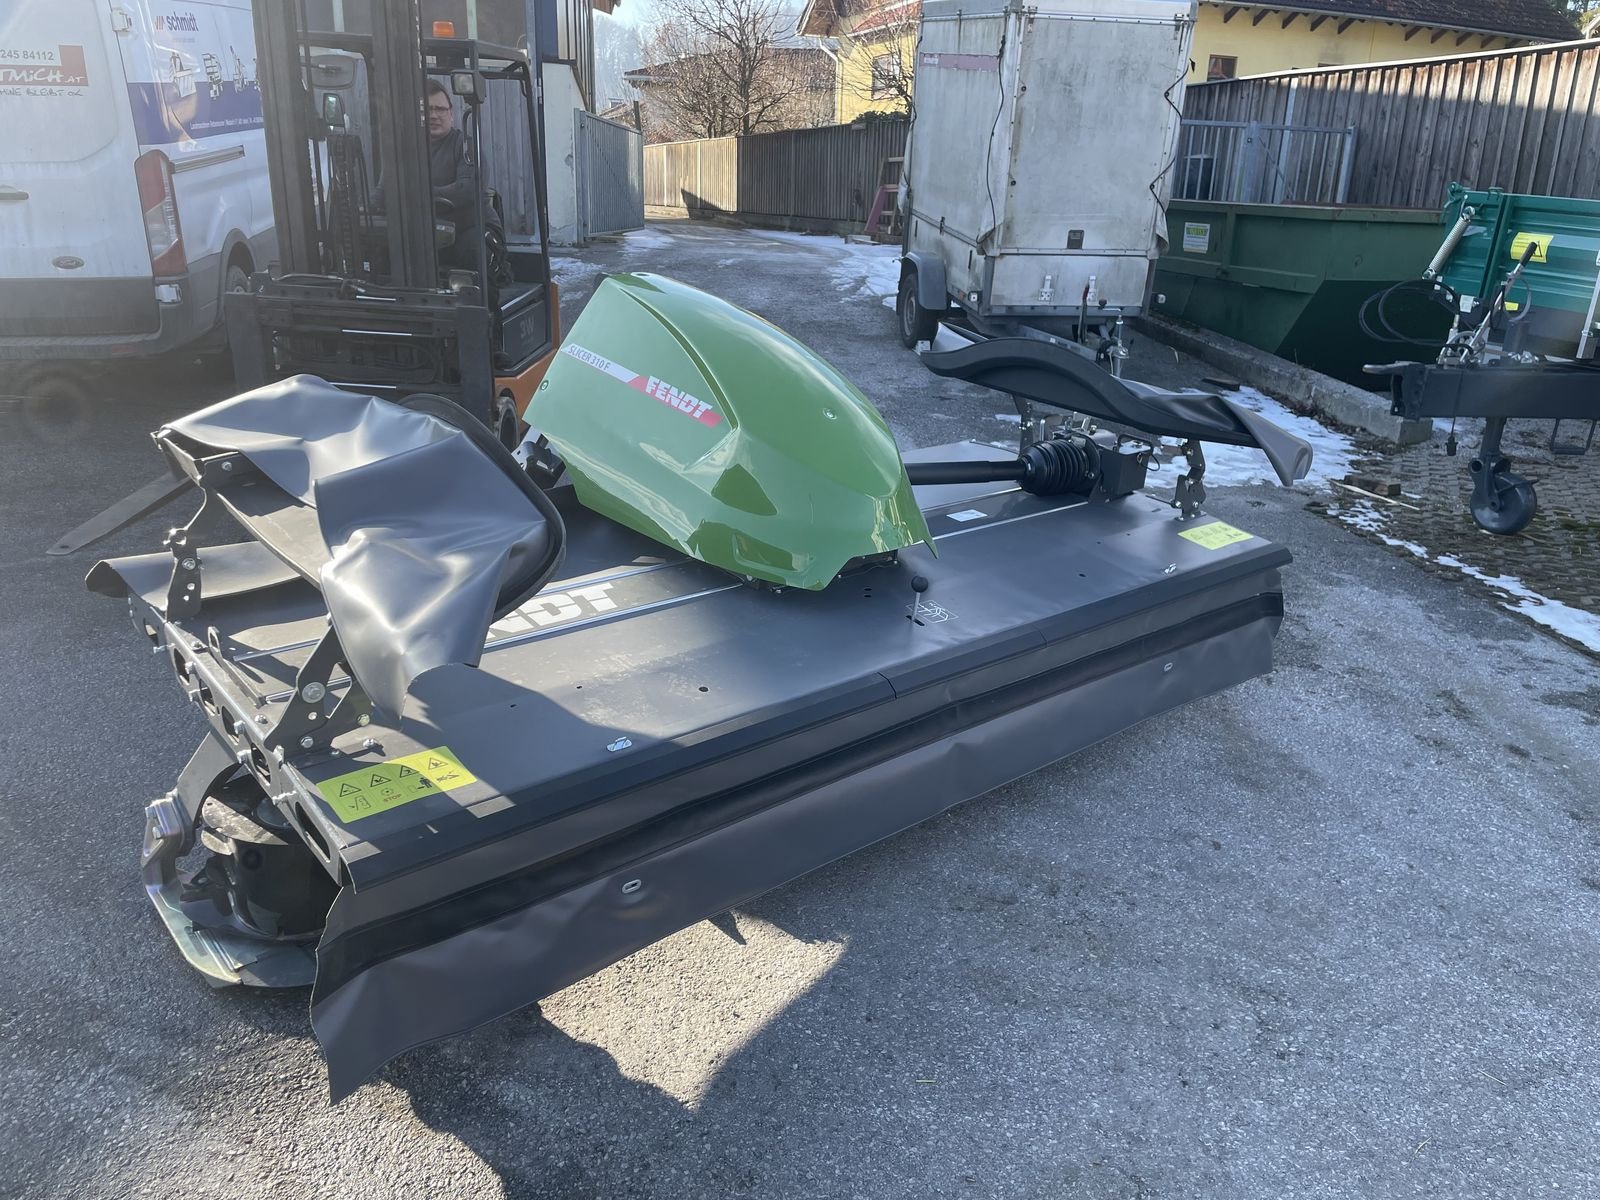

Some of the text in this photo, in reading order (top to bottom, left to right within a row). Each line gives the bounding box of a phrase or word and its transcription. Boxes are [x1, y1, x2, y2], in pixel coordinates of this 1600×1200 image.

[166, 10, 199, 32] schmidt
[23, 50, 54, 61] 84112
[567, 344, 612, 371] SLICER 310 F
[645, 375, 713, 418] FENDT
